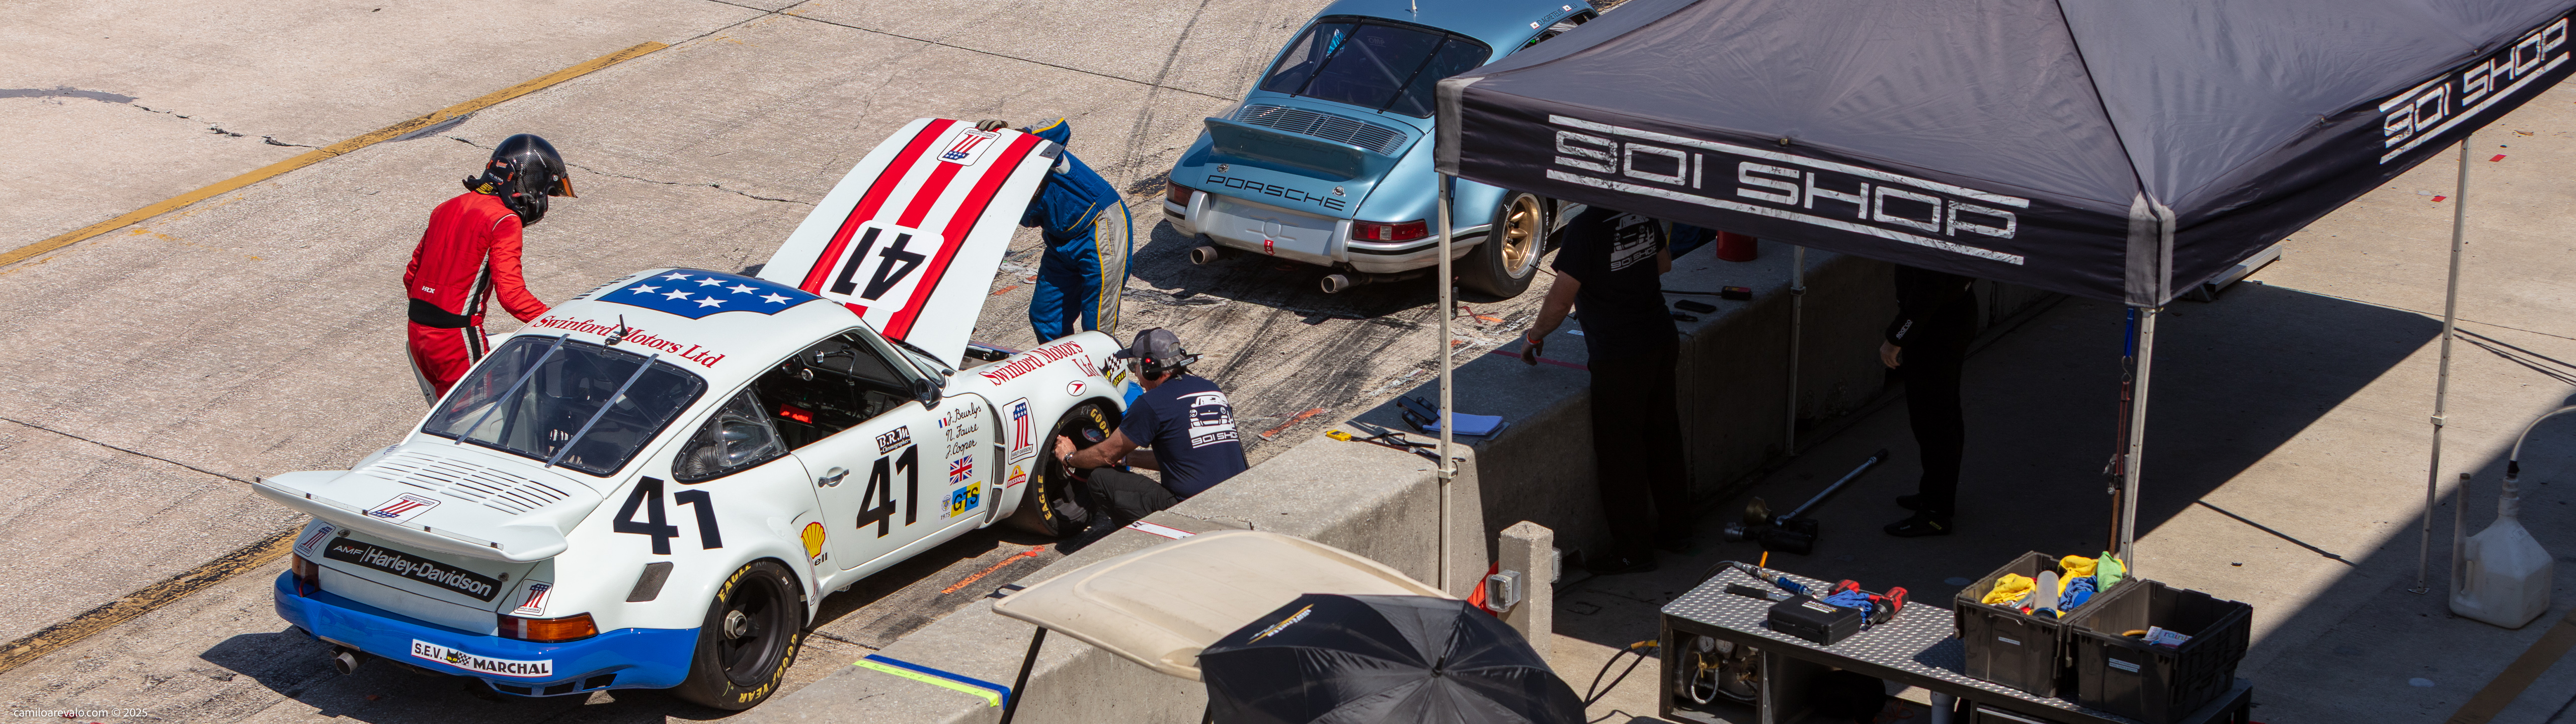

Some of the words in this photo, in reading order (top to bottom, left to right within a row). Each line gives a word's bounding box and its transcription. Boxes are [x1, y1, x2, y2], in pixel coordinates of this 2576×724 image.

[1537, 8, 1564, 26] D.AGRETELIS
[2384, 82, 2451, 148] 901
[2462, 17, 2568, 107] SHOP
[1205, 174, 1346, 212] PORSCHE
[1555, 130, 1703, 190] 901
[1737, 161, 2017, 240] SHOP
[830, 226, 927, 301] 41
[422, 285, 436, 294] HRX
[531, 315, 620, 336] Swinford
[620, 326, 684, 354] Motors
[678, 344, 726, 369] Ltd
[1896, 319, 1912, 338] sparco
[978, 352, 1045, 387] Swinford
[1031, 340, 1083, 364] Motors
[1071, 354, 1101, 378] Ltd
[952, 439, 978, 456] Cooper
[956, 423, 979, 438] Faure
[1191, 434, 1216, 446] 901
[856, 443, 919, 539] 41
[953, 486, 979, 512] GTS
[1037, 475, 1053, 521] EAGLE
[613, 475, 723, 555] 41
[940, 511, 950, 520] 1975
[333, 545, 364, 555] AMF
[364, 548, 492, 597] Harley-Davidson
[814, 552, 828, 567] ell
[718, 563, 752, 603] EAGLE
[414, 643, 443, 660] S.E.V.
[473, 657, 549, 675] MARCHAL
